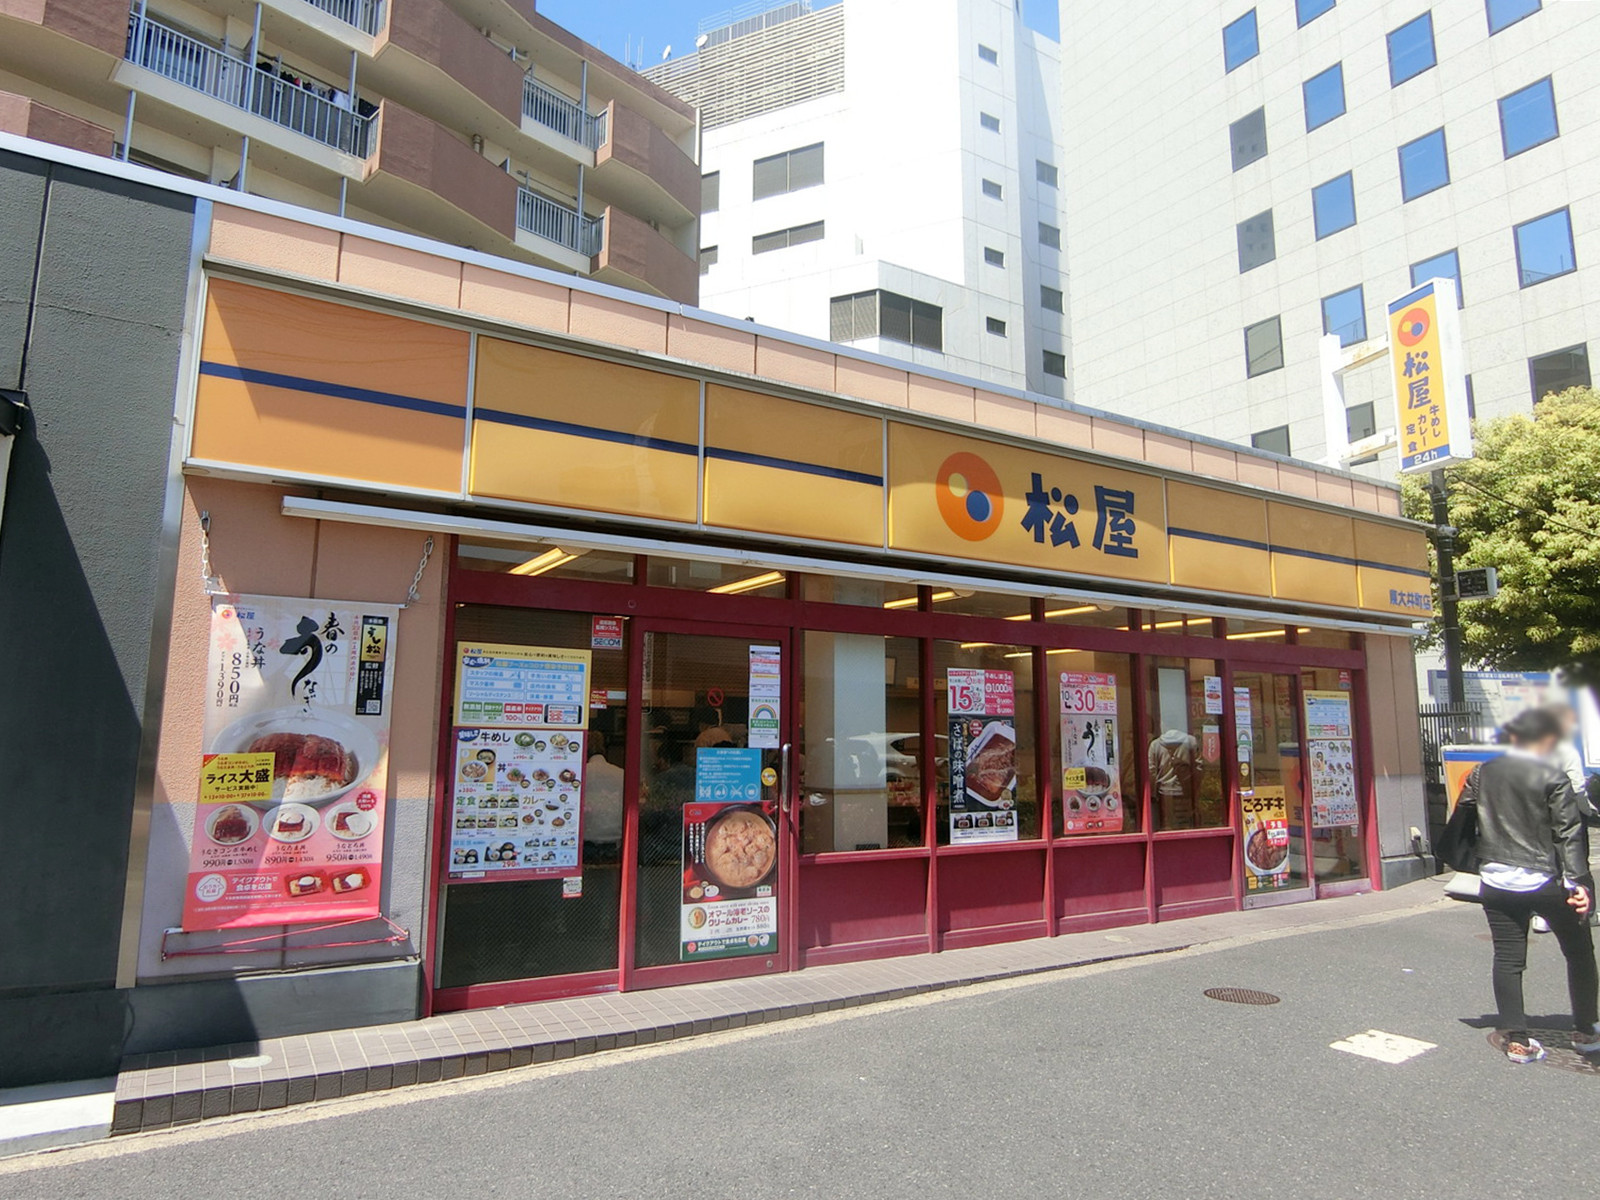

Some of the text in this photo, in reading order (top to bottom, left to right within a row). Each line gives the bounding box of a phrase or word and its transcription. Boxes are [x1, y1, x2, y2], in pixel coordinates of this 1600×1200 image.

[1403, 350, 1431, 410] 松屋
[1417, 414, 1427, 447] カレー
[1429, 404, 1441, 438] 牛めし
[1406, 423, 1417, 453] 定食
[1414, 450, 1438, 465] 24h
[1020, 472, 1139, 559] 松屋
[320, 611, 345, 655] 春の
[594, 637, 621, 646] SECOM
[949, 685, 973, 710] 15
[1074, 689, 1095, 712] 30
[480, 732, 511, 743] 牛めし
[952, 723, 965, 804] さばの味噌煮
[206, 768, 270, 784] ライス大盛
[456, 795, 476, 806] 定食
[522, 795, 546, 805] カレー
[708, 917, 749, 927] クリームカレー
